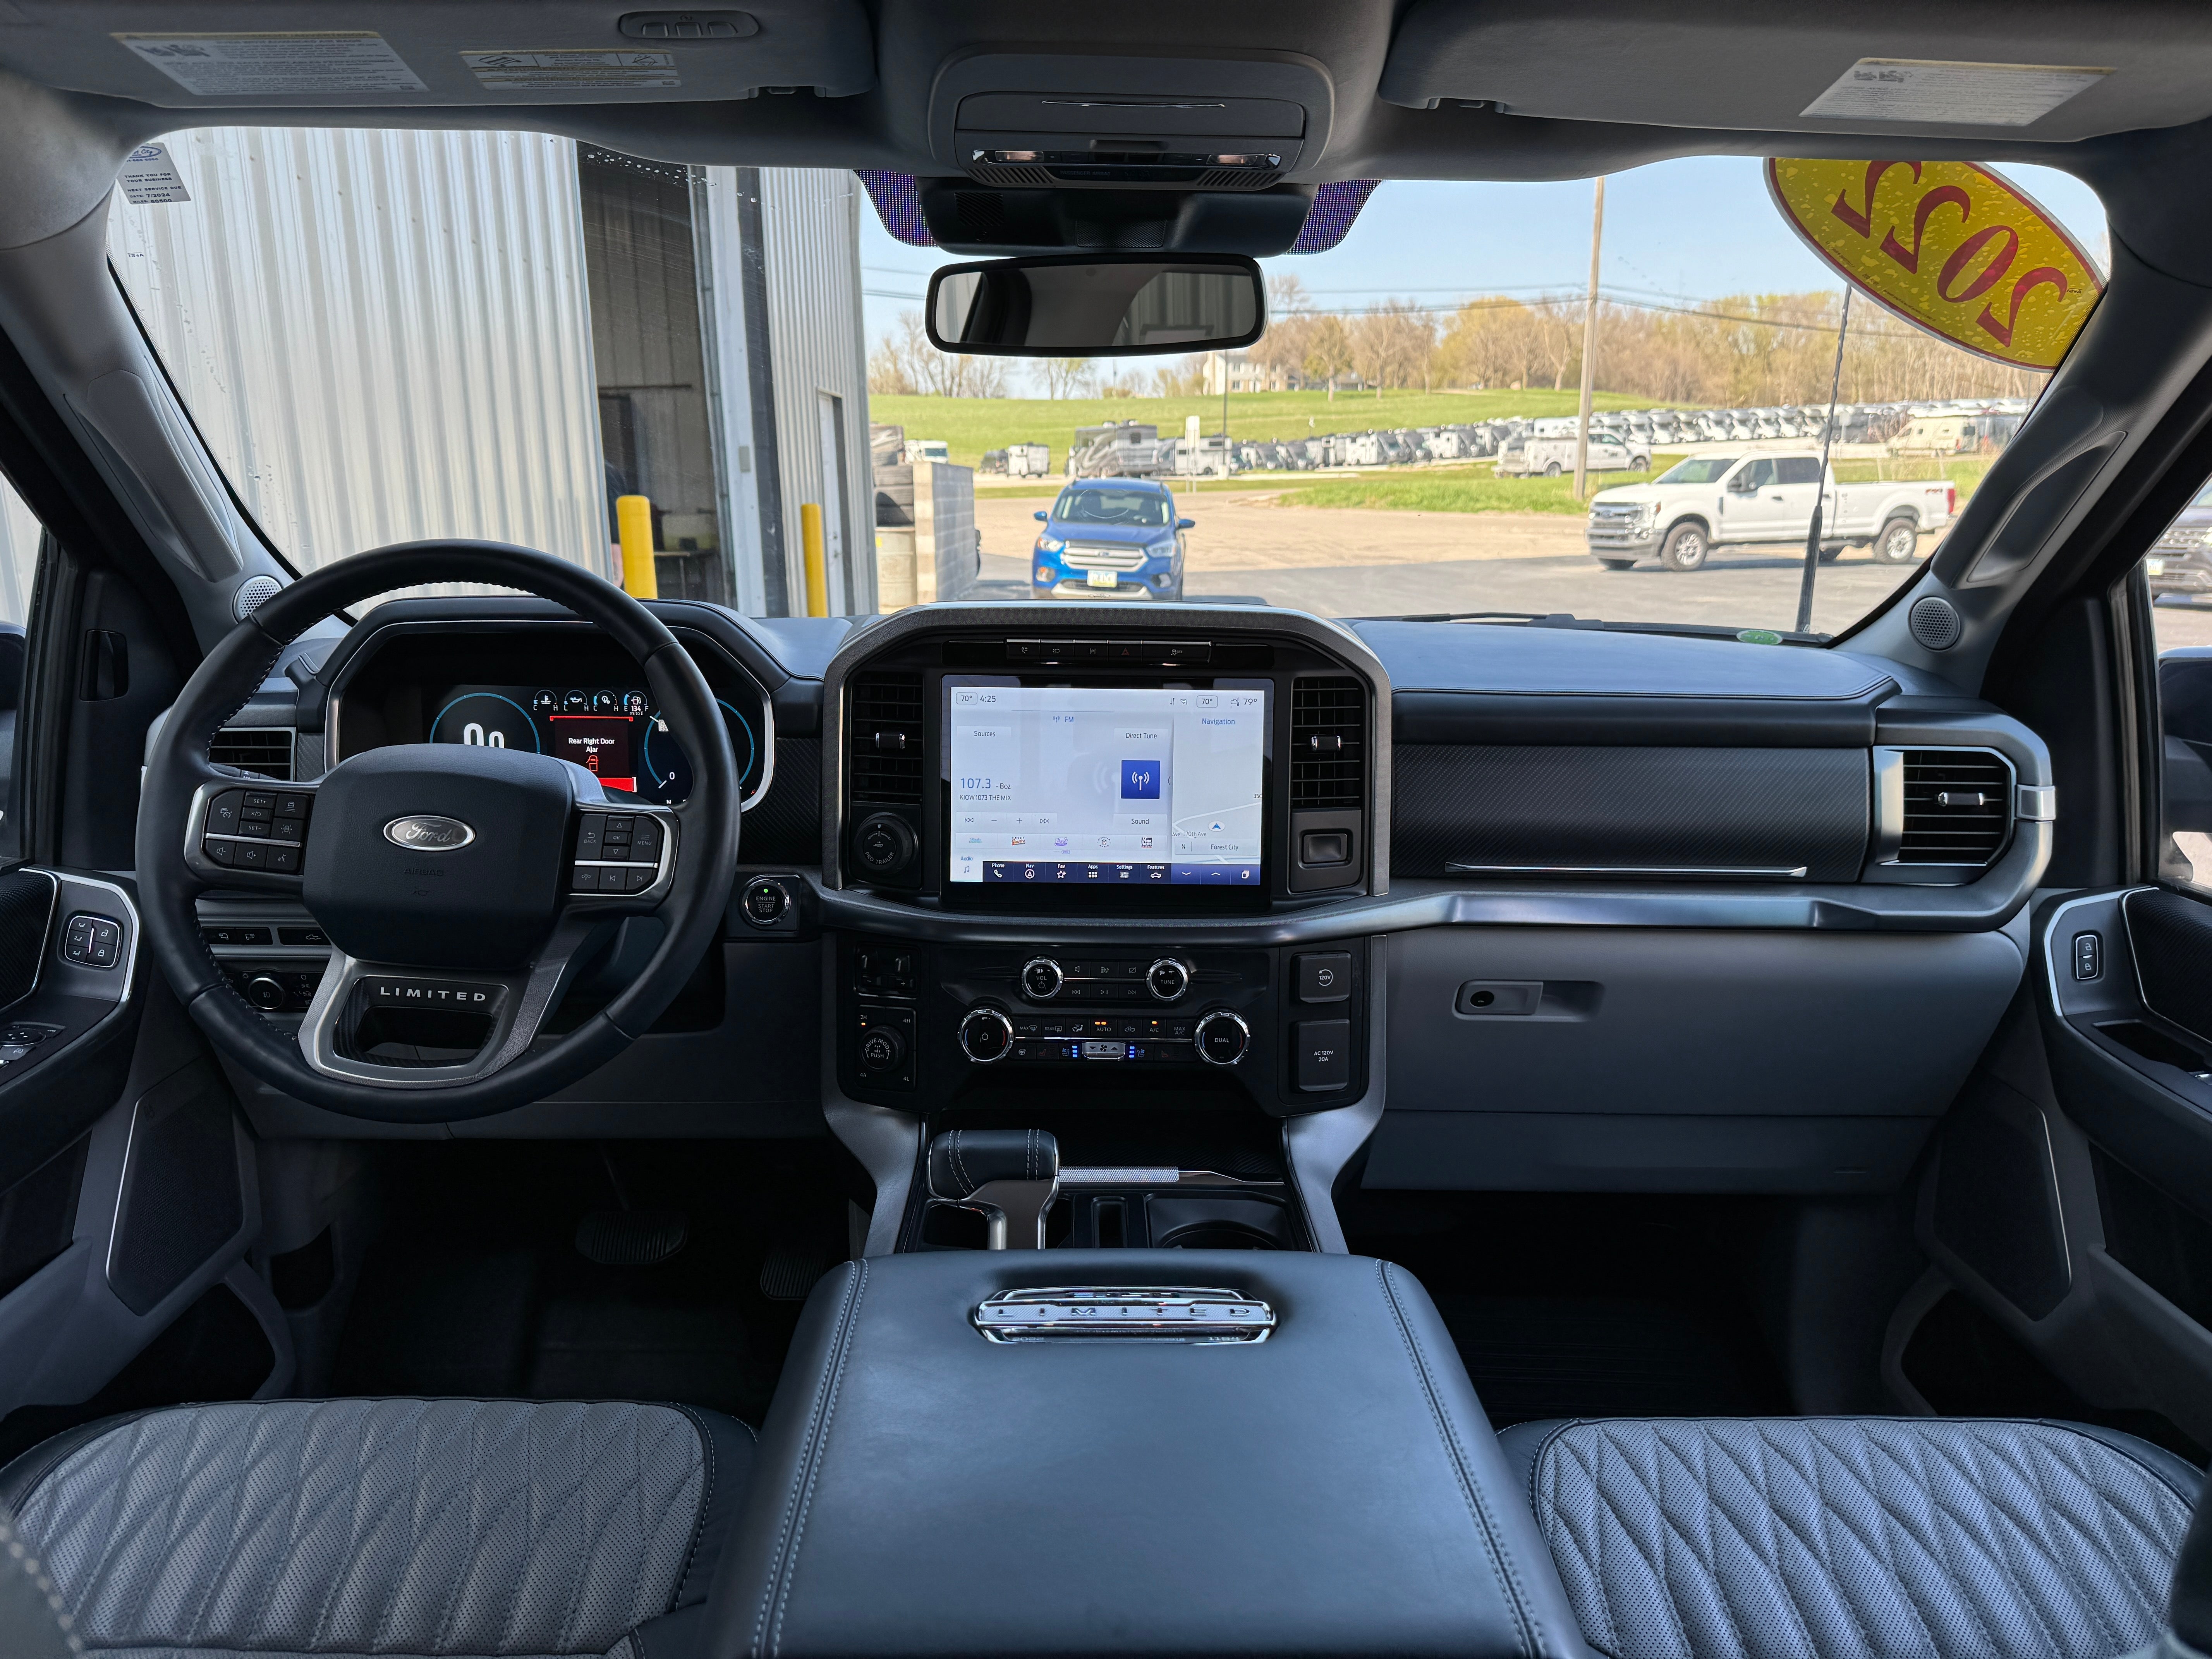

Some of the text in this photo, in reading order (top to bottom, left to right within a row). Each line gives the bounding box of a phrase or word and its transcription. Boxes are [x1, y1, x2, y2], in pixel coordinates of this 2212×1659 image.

[669, 772, 675, 780] 0
[960, 778, 991, 789] 107.3
[405, 822, 453, 843] Ford
[865, 852, 895, 865] PRO TRAILER
[404, 868, 444, 876] AIRBAG
[380, 986, 486, 1001] LIMITED
[865, 1038, 891, 1053] DRIVE MODE
[998, 1306, 1250, 1317] LIMITED
